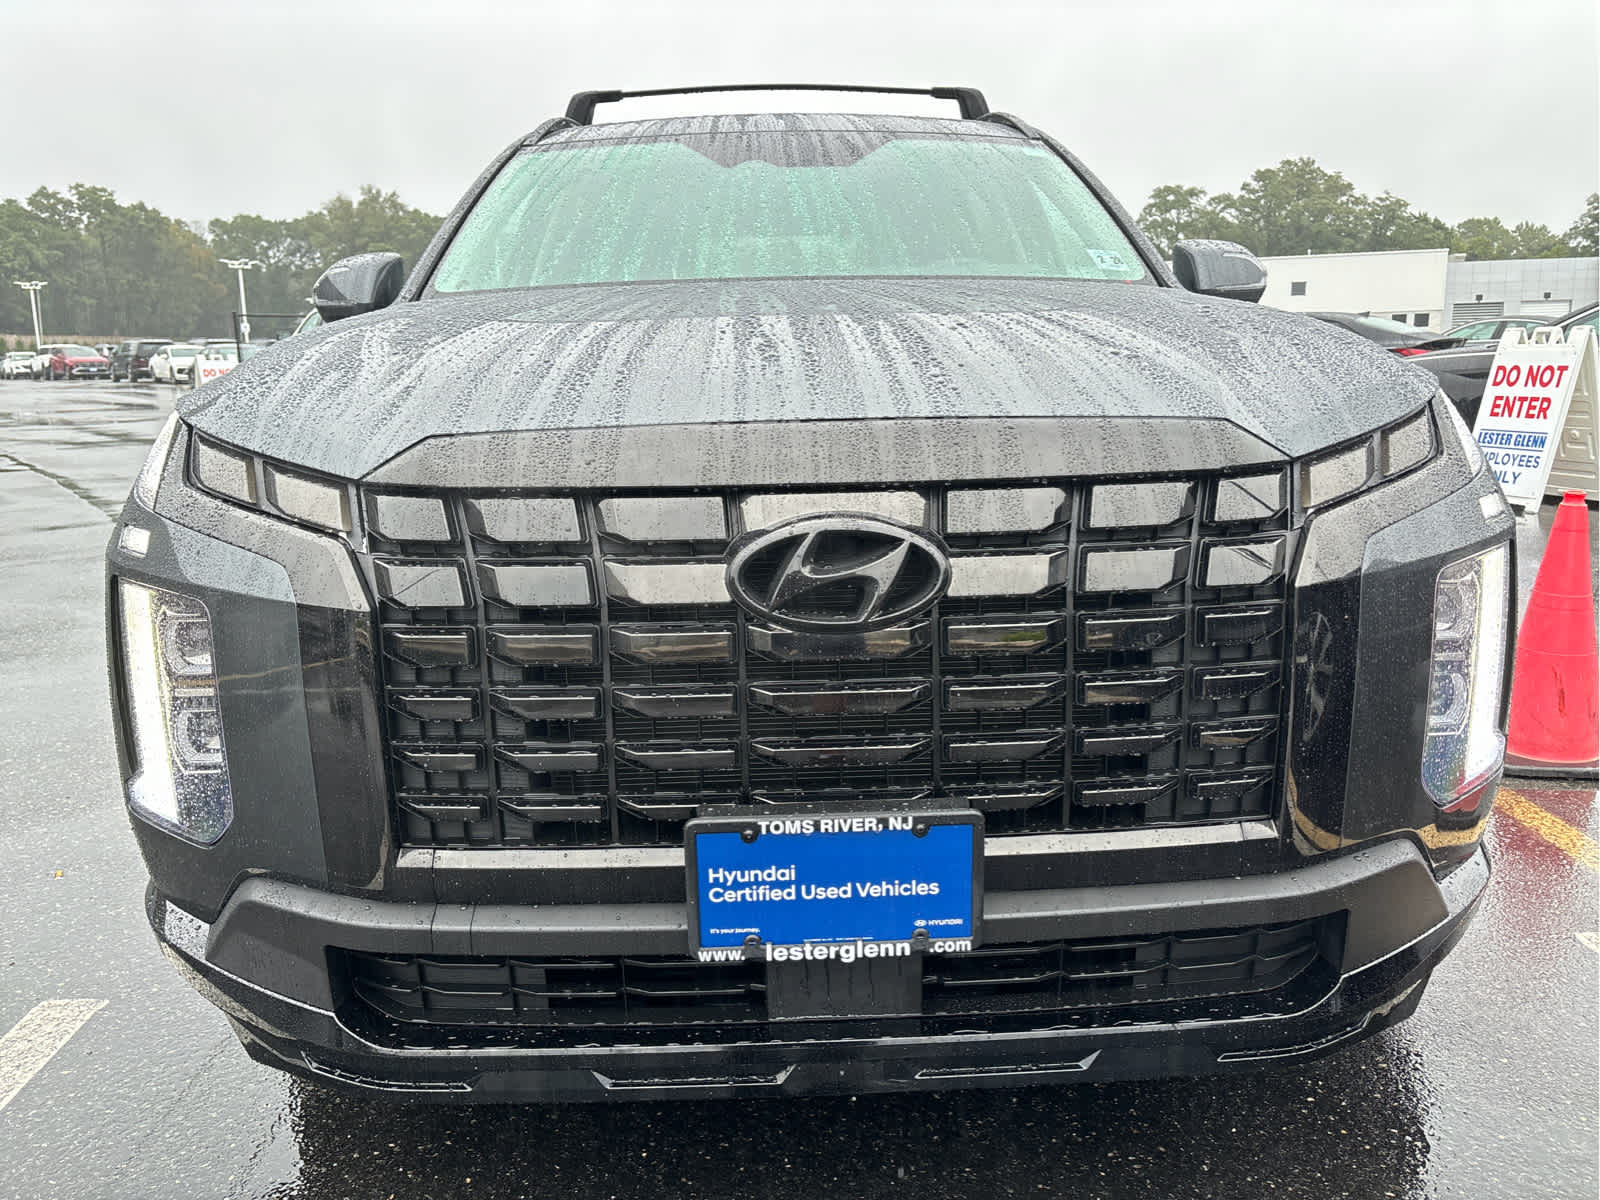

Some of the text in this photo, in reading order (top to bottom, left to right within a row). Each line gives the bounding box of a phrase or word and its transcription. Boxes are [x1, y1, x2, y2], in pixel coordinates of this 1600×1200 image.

[202, 368, 217, 377] DO
[1491, 365, 1569, 388] DO NOT
[1489, 395, 1552, 420] ENTER
[1477, 431, 1548, 449] LESTER GLENN
[1485, 451, 1541, 469] PLOYEES
[1493, 469, 1522, 485] NLY
[757, 815, 914, 835] TOMS RIVER, NJ
[707, 864, 797, 887] Hyundai
[708, 879, 941, 903] Certified Used Vehicles
[927, 918, 964, 926] HYUNDAI
[697, 949, 746, 962] www.
[765, 939, 912, 964] lesterglenn
[928, 939, 972, 953] .com
